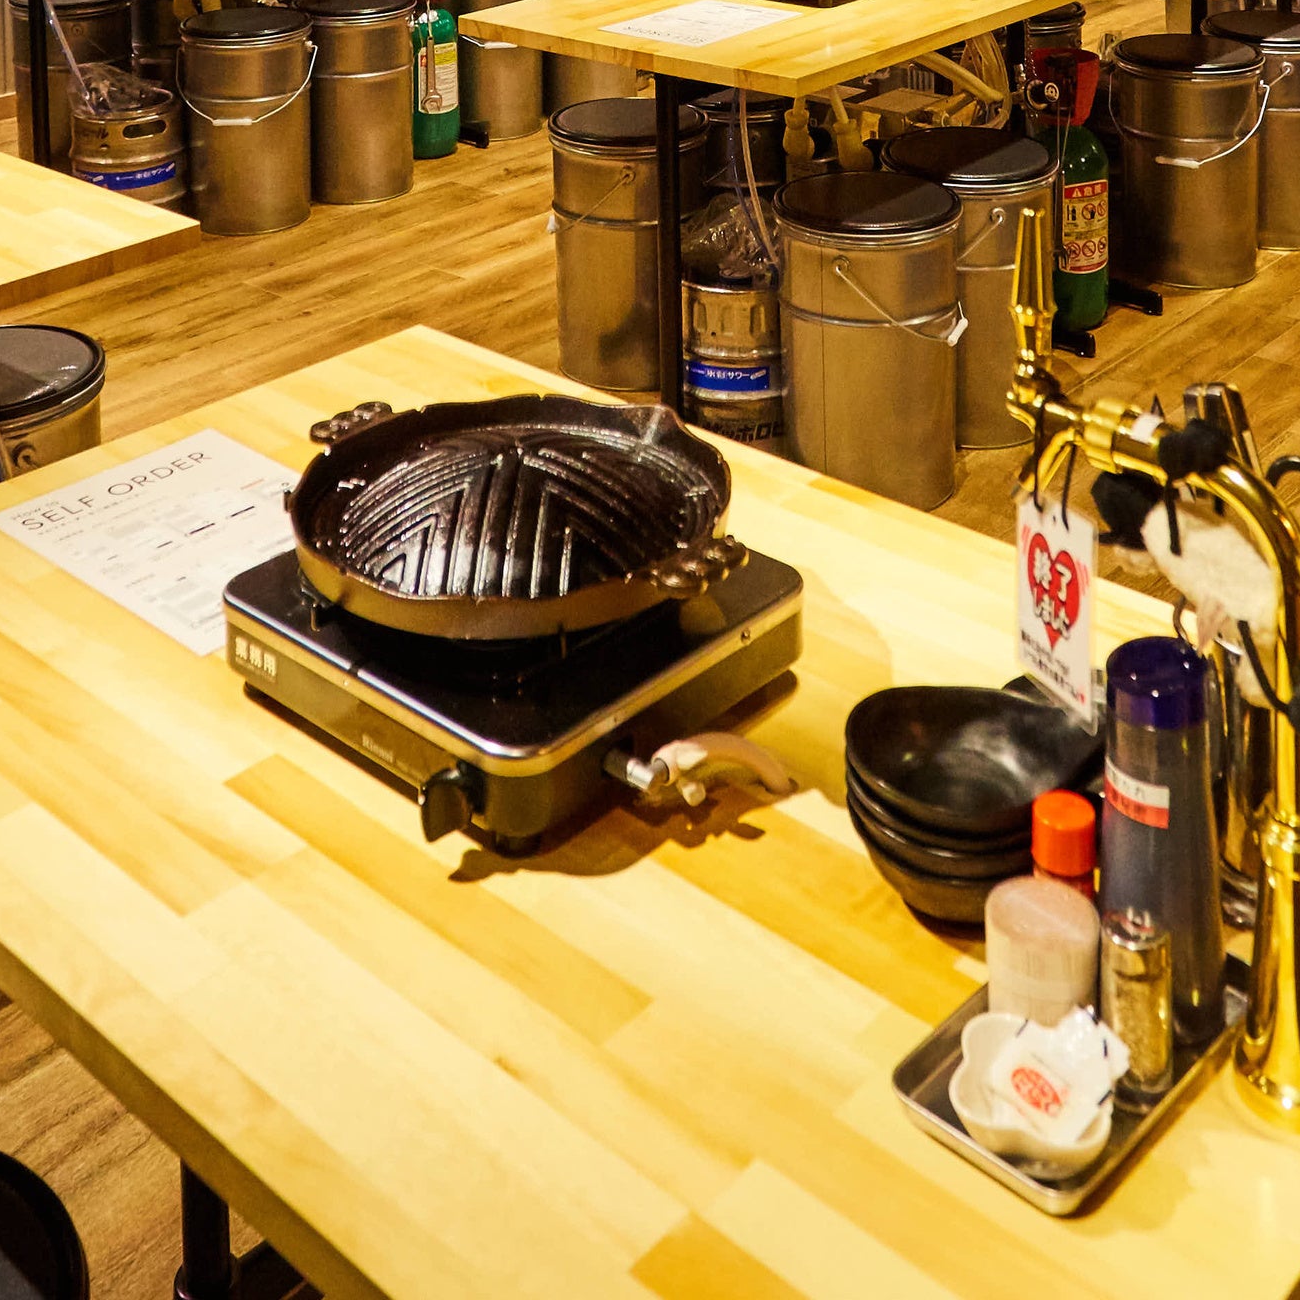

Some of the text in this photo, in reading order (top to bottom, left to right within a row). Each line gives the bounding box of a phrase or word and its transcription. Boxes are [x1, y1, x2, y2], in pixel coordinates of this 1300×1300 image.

[21, 452, 213, 530] SELF ORDER
[1031, 546, 1073, 602] 終了
[1032, 585, 1073, 640] しました
